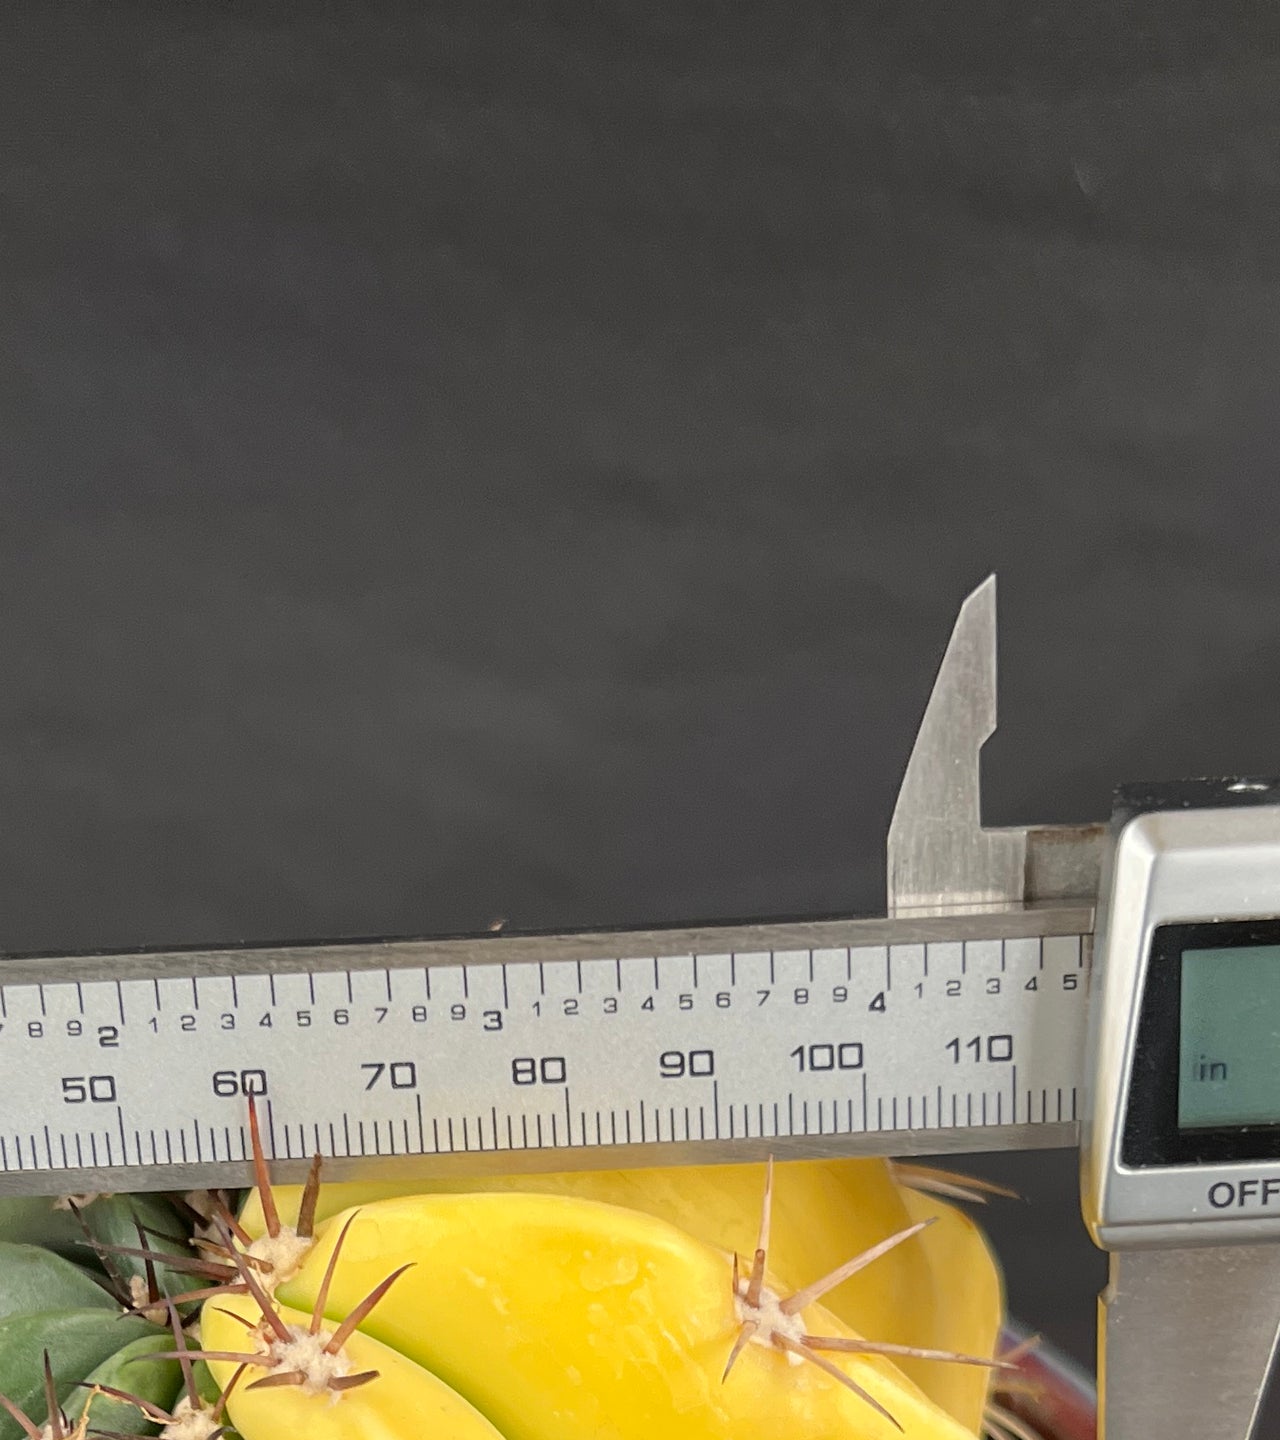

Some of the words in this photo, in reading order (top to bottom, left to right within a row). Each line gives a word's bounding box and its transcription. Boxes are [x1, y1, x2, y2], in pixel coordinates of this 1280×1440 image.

[27, 1021, 44, 1039] 8
[66, 1019, 83, 1037] 9
[97, 1025, 120, 1049] 2
[147, 1016, 159, 1034] 1
[180, 1014, 197, 1032] 2
[220, 1012, 236, 1031] 3
[258, 1011, 274, 1029] 4
[296, 1010, 312, 1028] 5
[333, 1008, 350, 1026] 6
[374, 1006, 389, 1024] 7
[411, 1005, 428, 1023] 8
[450, 1003, 467, 1021] 9
[482, 1009, 504, 1032] 3
[531, 1000, 542, 1018] 1
[562, 998, 580, 1016] 2
[603, 996, 618, 1015] 3
[640, 995, 655, 1012] 4
[678, 993, 694, 1011] 5
[715, 991, 732, 1009] 6
[756, 989, 771, 1007] 7
[793, 987, 810, 1005] 8
[832, 985, 849, 1003] 9
[868, 990, 887, 1014] 4
[913, 982, 924, 999] 1
[945, 979, 962, 997] 2
[985, 977, 1001, 995] 3
[1024, 975, 1039, 992] 4
[1062, 973, 1078, 991] 5
[60, 1074, 117, 1104] 50
[212, 1068, 268, 1098] 60
[360, 1061, 417, 1092] 70
[511, 1056, 567, 1086] 80
[659, 1049, 715, 1079] 90
[789, 1041, 864, 1073] 100
[945, 1034, 1014, 1065] 110
[1194, 1054, 1228, 1082] in
